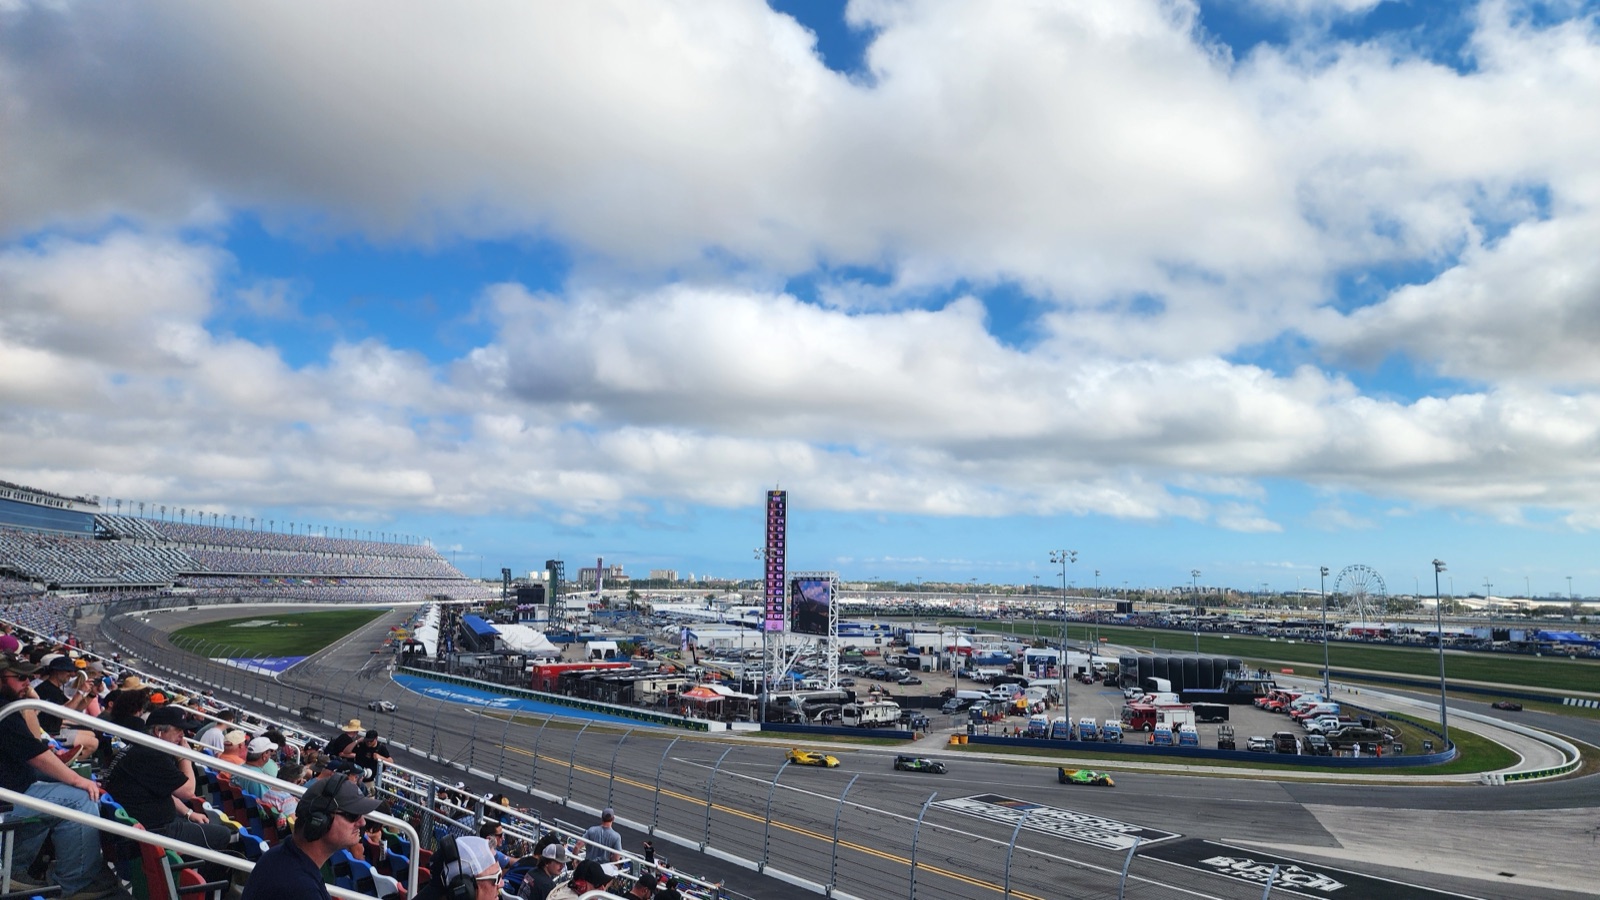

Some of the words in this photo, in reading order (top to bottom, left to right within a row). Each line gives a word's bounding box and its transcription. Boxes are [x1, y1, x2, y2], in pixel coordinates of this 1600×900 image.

[13, 491, 34, 502] CENTER
[44, 497, 64, 508] RACING
[1199, 856, 1347, 892] BUSCH
